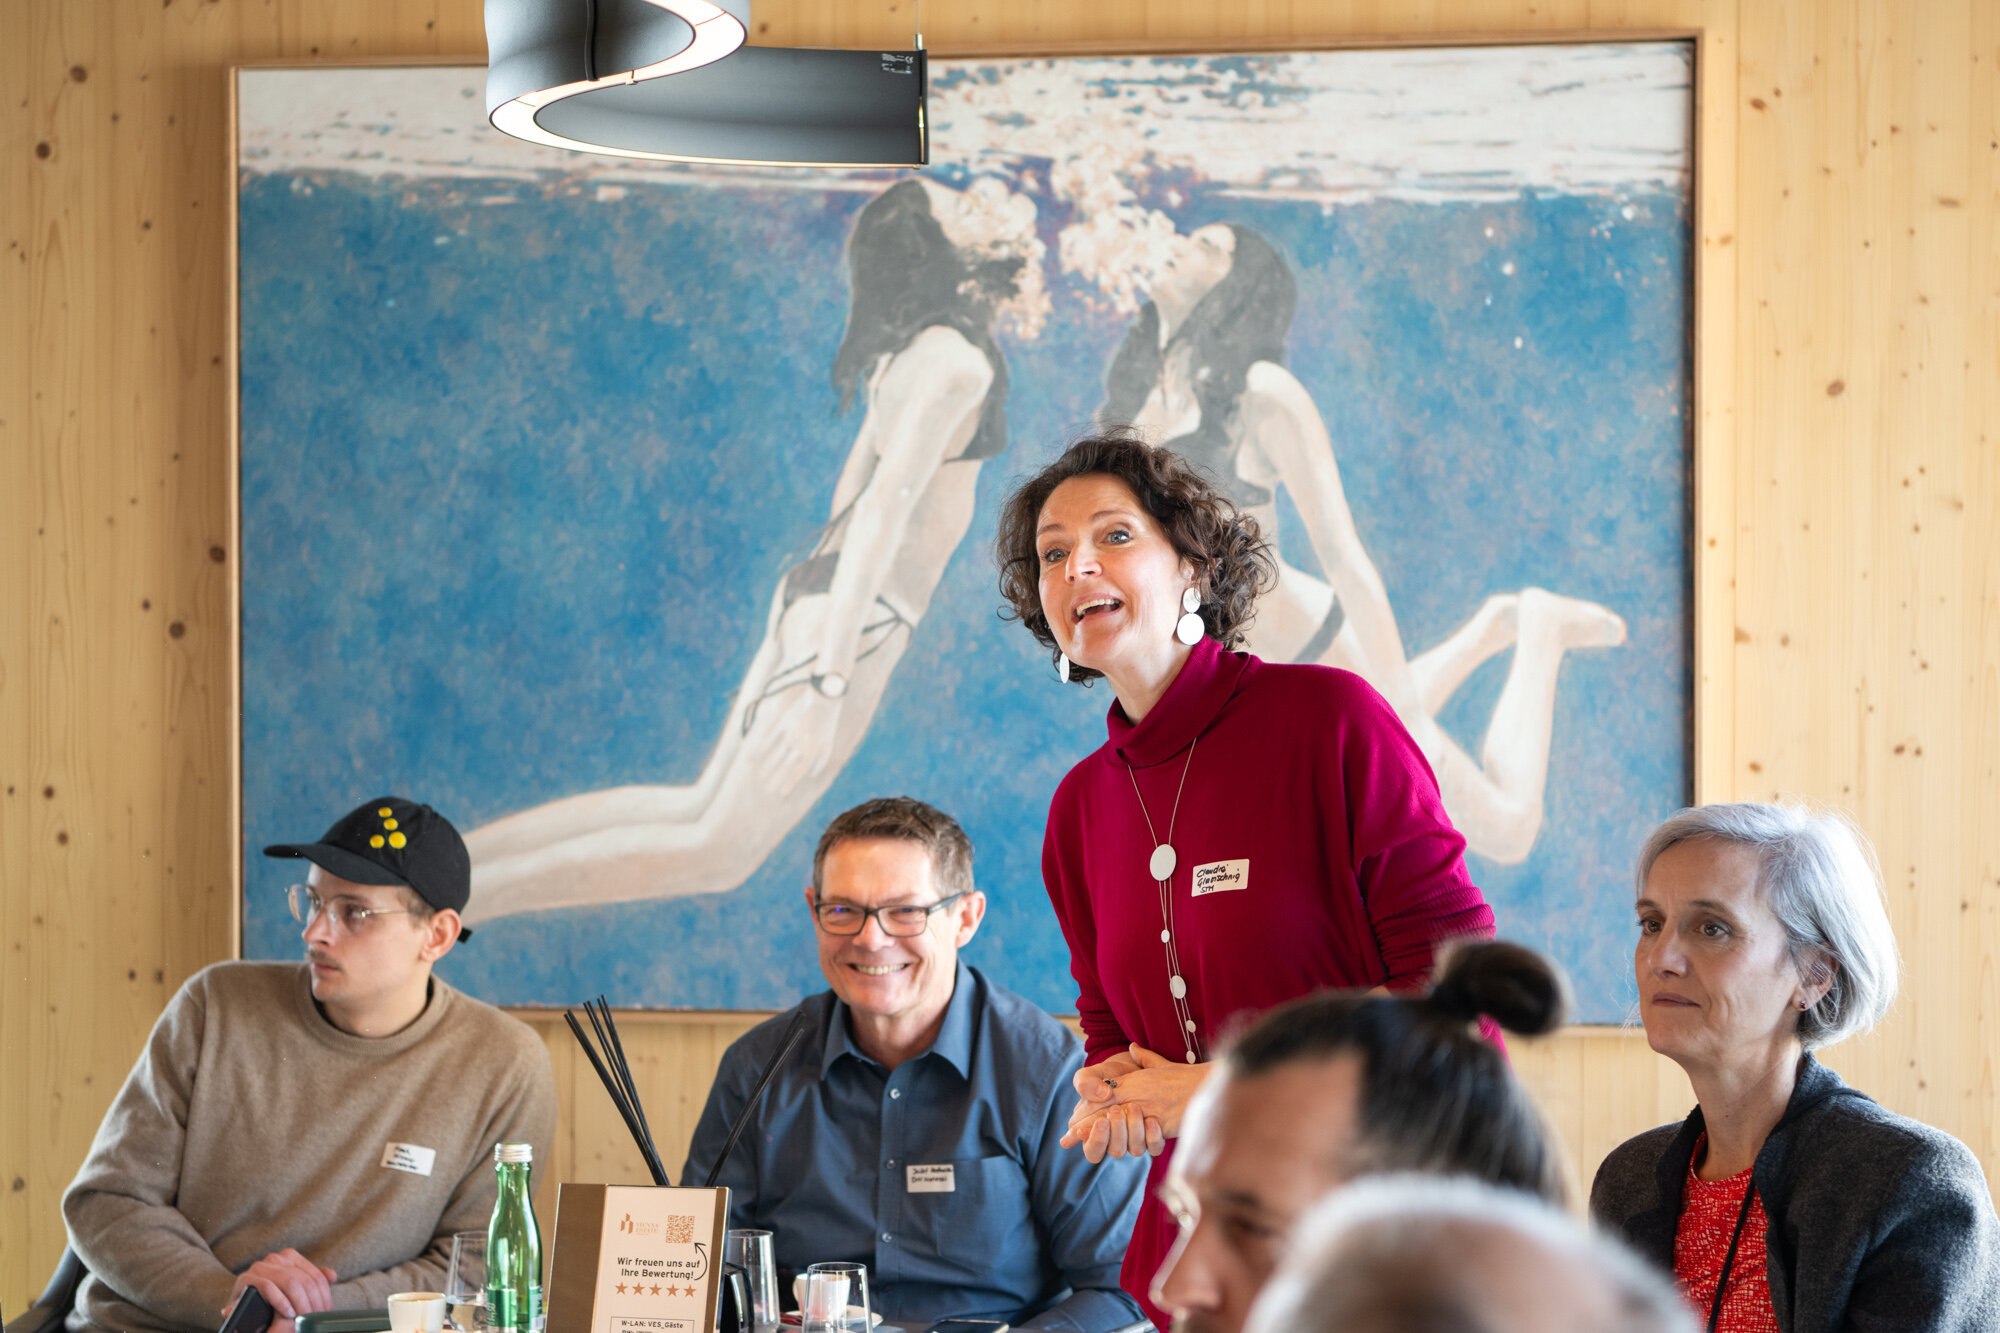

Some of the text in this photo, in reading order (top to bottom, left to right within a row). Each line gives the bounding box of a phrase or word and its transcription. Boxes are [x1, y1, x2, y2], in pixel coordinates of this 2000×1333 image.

[617, 1257, 633, 1266] Wir
[635, 1258, 664, 1267] freuen
[685, 1259, 700, 1268] auf
[621, 1268, 694, 1280] Ihre Bewertung!
[647, 1321, 684, 1329] VES_Gäste
